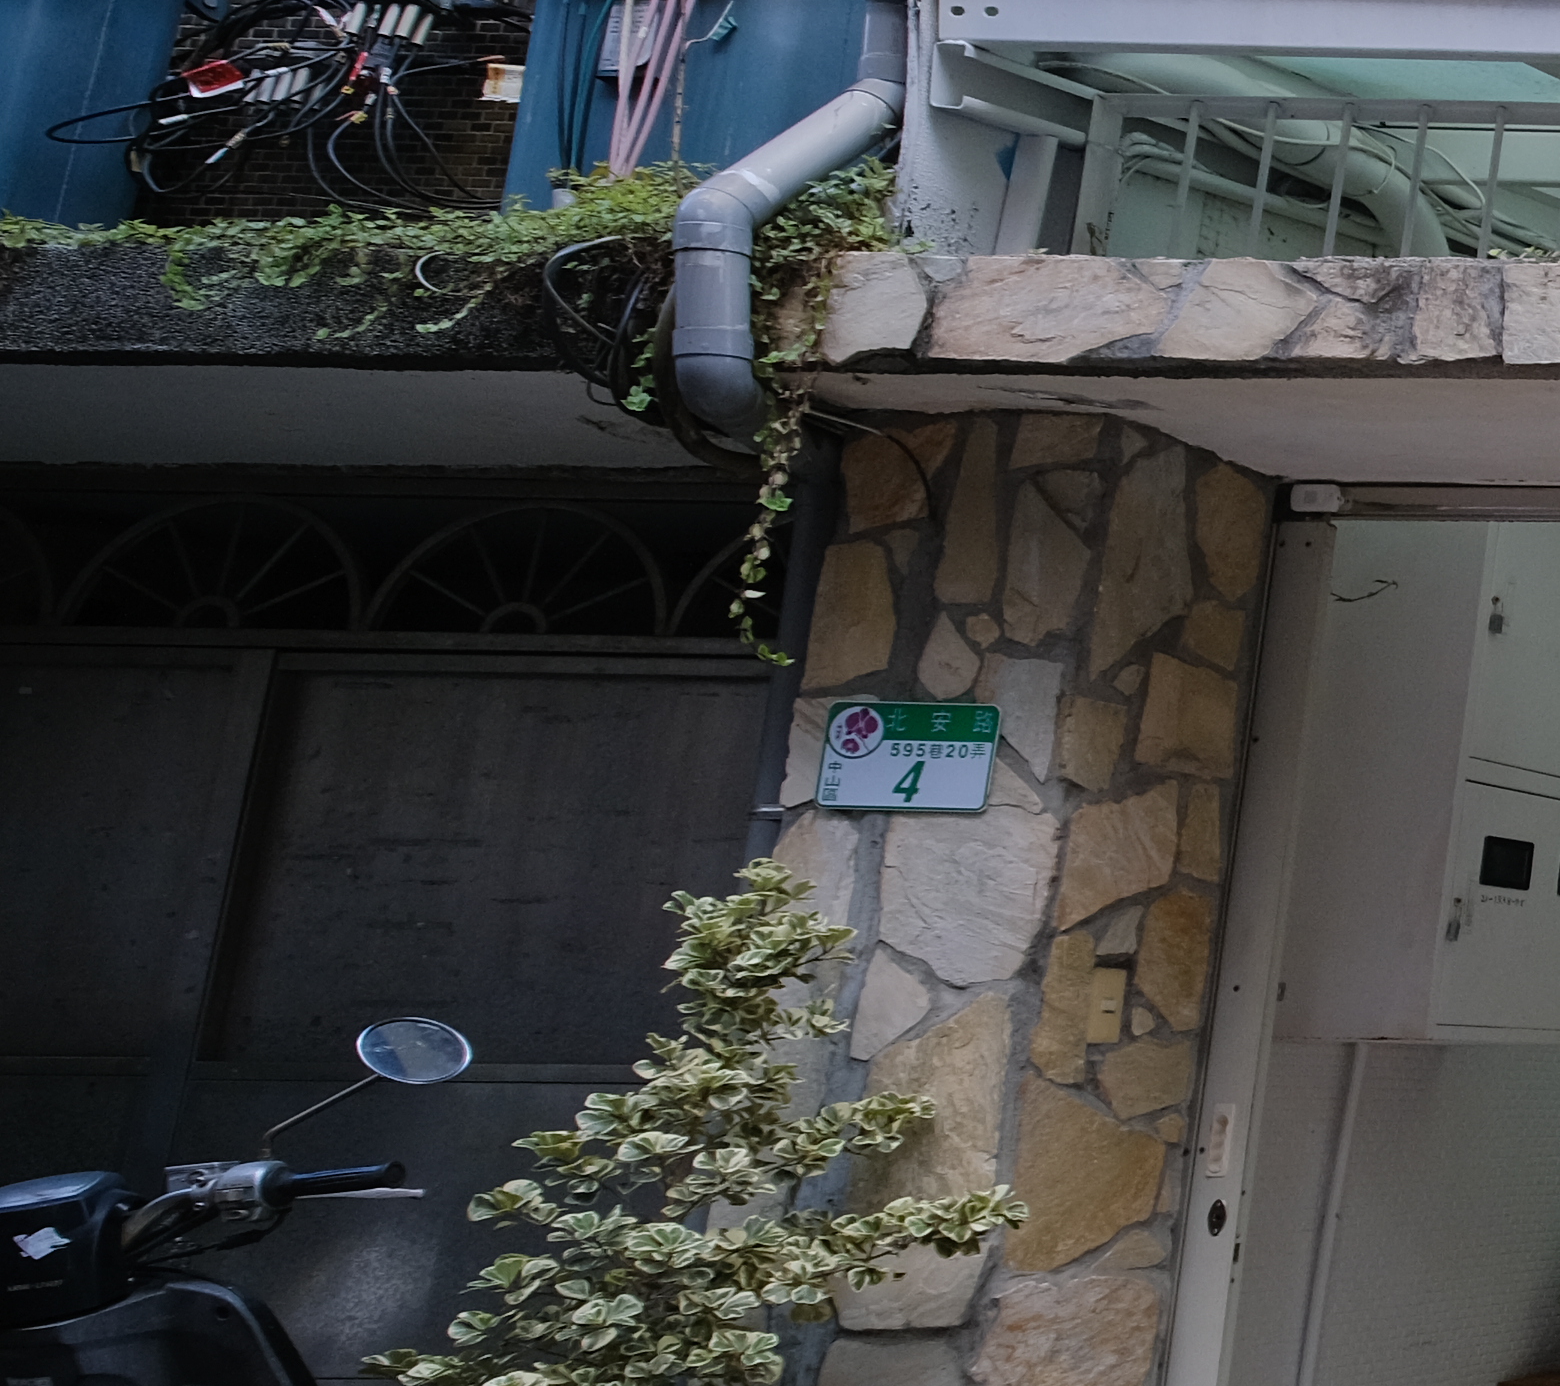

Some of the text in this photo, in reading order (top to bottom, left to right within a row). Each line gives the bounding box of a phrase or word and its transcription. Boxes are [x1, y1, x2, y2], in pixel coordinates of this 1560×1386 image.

[886, 708, 993, 734] 北安路
[890, 742, 987, 760] 595巷20弄
[892, 760, 926, 803] 4
